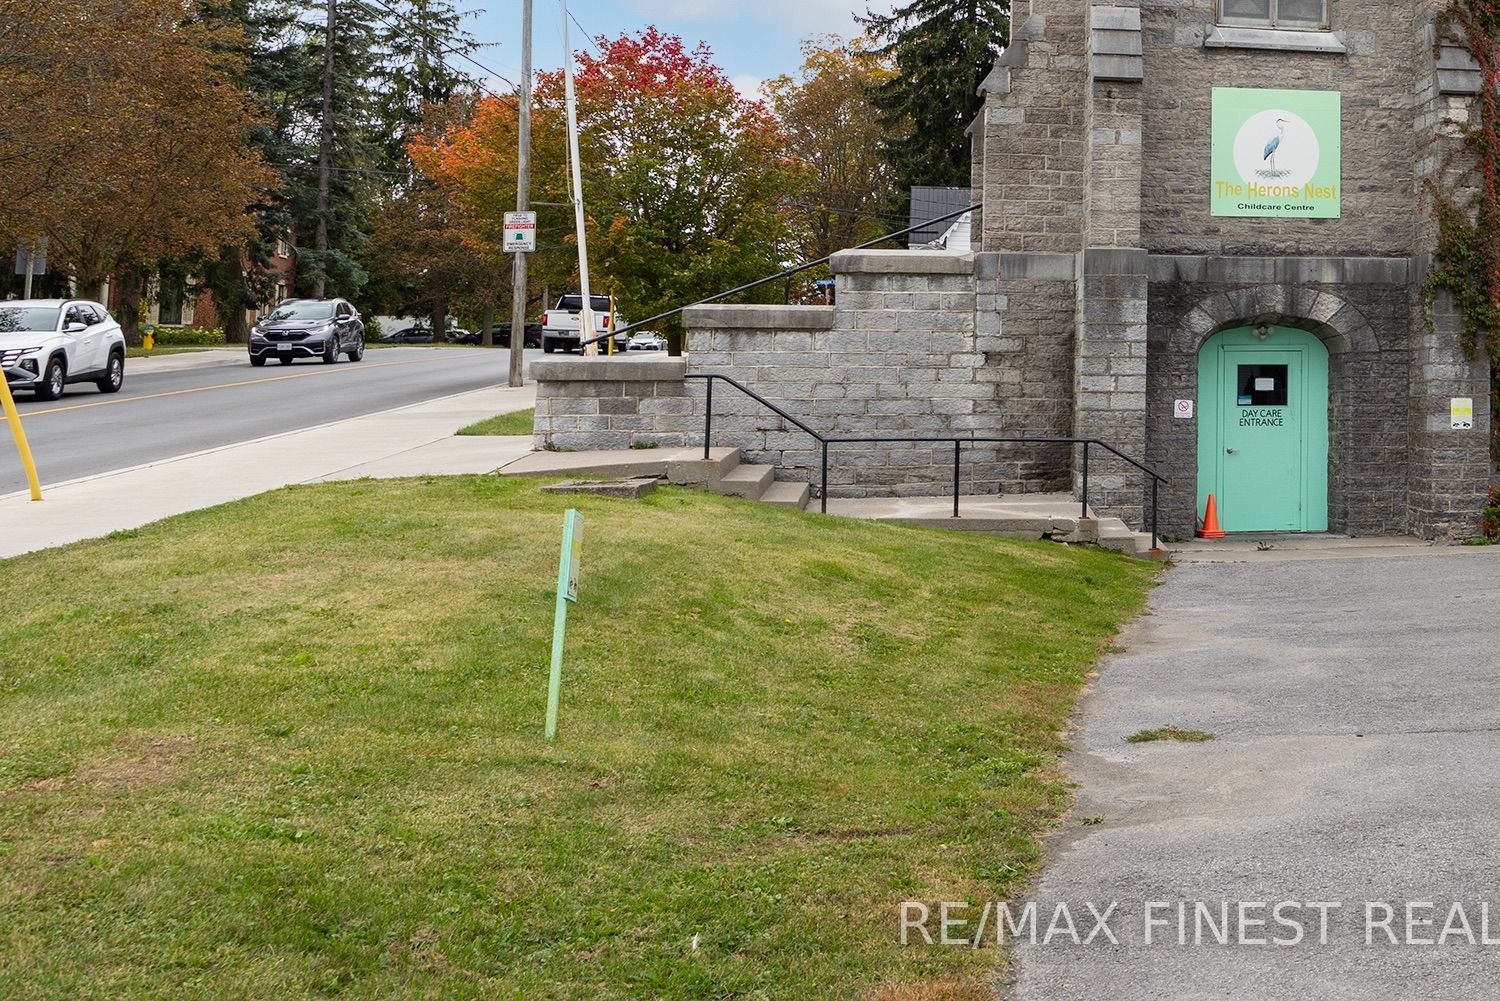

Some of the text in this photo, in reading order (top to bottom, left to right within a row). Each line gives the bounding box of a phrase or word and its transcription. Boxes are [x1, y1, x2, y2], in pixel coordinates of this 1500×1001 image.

[1215, 181, 1337, 200] The Herons Nest
[1241, 409, 1282, 418] DAY CARE
[1239, 418, 1284, 427] ENTRANCE
